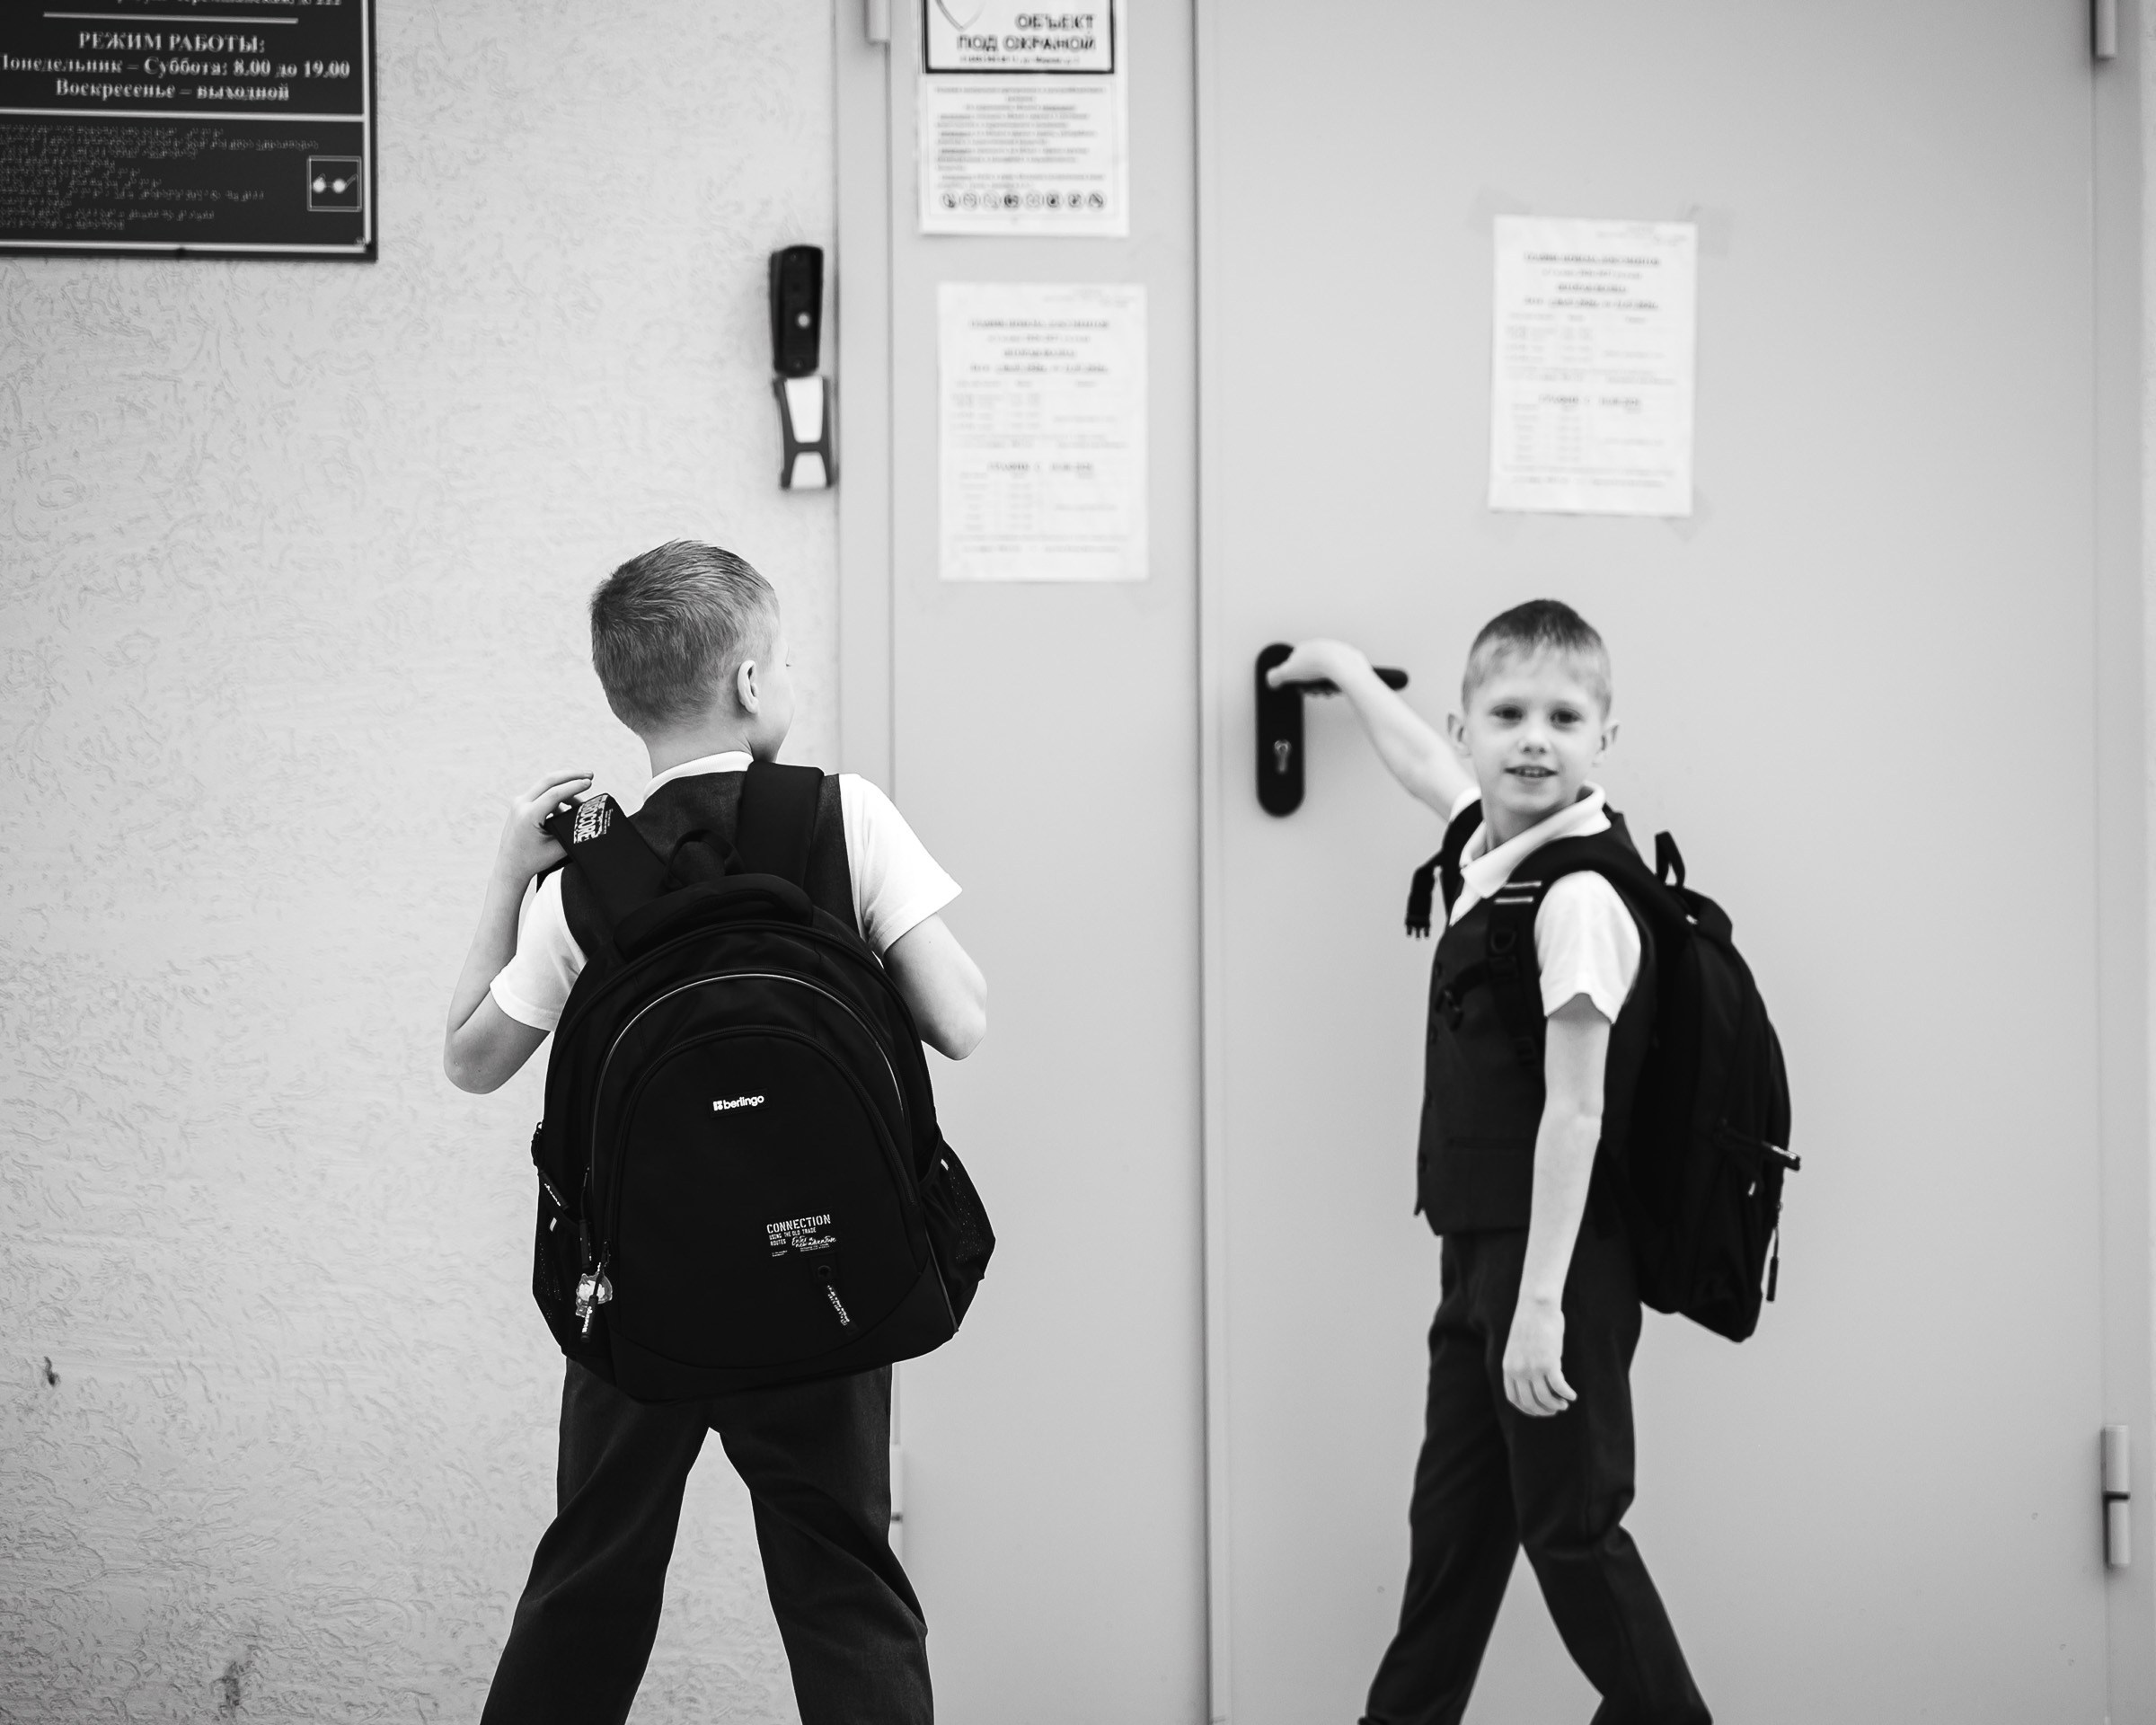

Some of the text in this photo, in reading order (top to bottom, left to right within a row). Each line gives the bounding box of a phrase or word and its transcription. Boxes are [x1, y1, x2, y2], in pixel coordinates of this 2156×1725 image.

[1016, 13, 1095, 31] ОБЪЕКТ
[78, 31, 265, 53] РЕЖИМ РАБОТЫ:
[957, 30, 1097, 52] ПОД ОХРАНОЙ
[144, 56, 228, 79] Суббота:
[234, 58, 271, 77] 8.00
[275, 62, 298, 78] до
[304, 59, 351, 79] 19.00
[56, 77, 176, 102] Воскресенье
[196, 83, 290, 102] выходной
[723, 1095, 764, 1110] berlingo
[766, 1214, 831, 1234] CONNECTION
[769, 1233, 782, 1241] USING
[801, 1226, 817, 1234] TRADE
[770, 1238, 787, 1246] ROUTES
